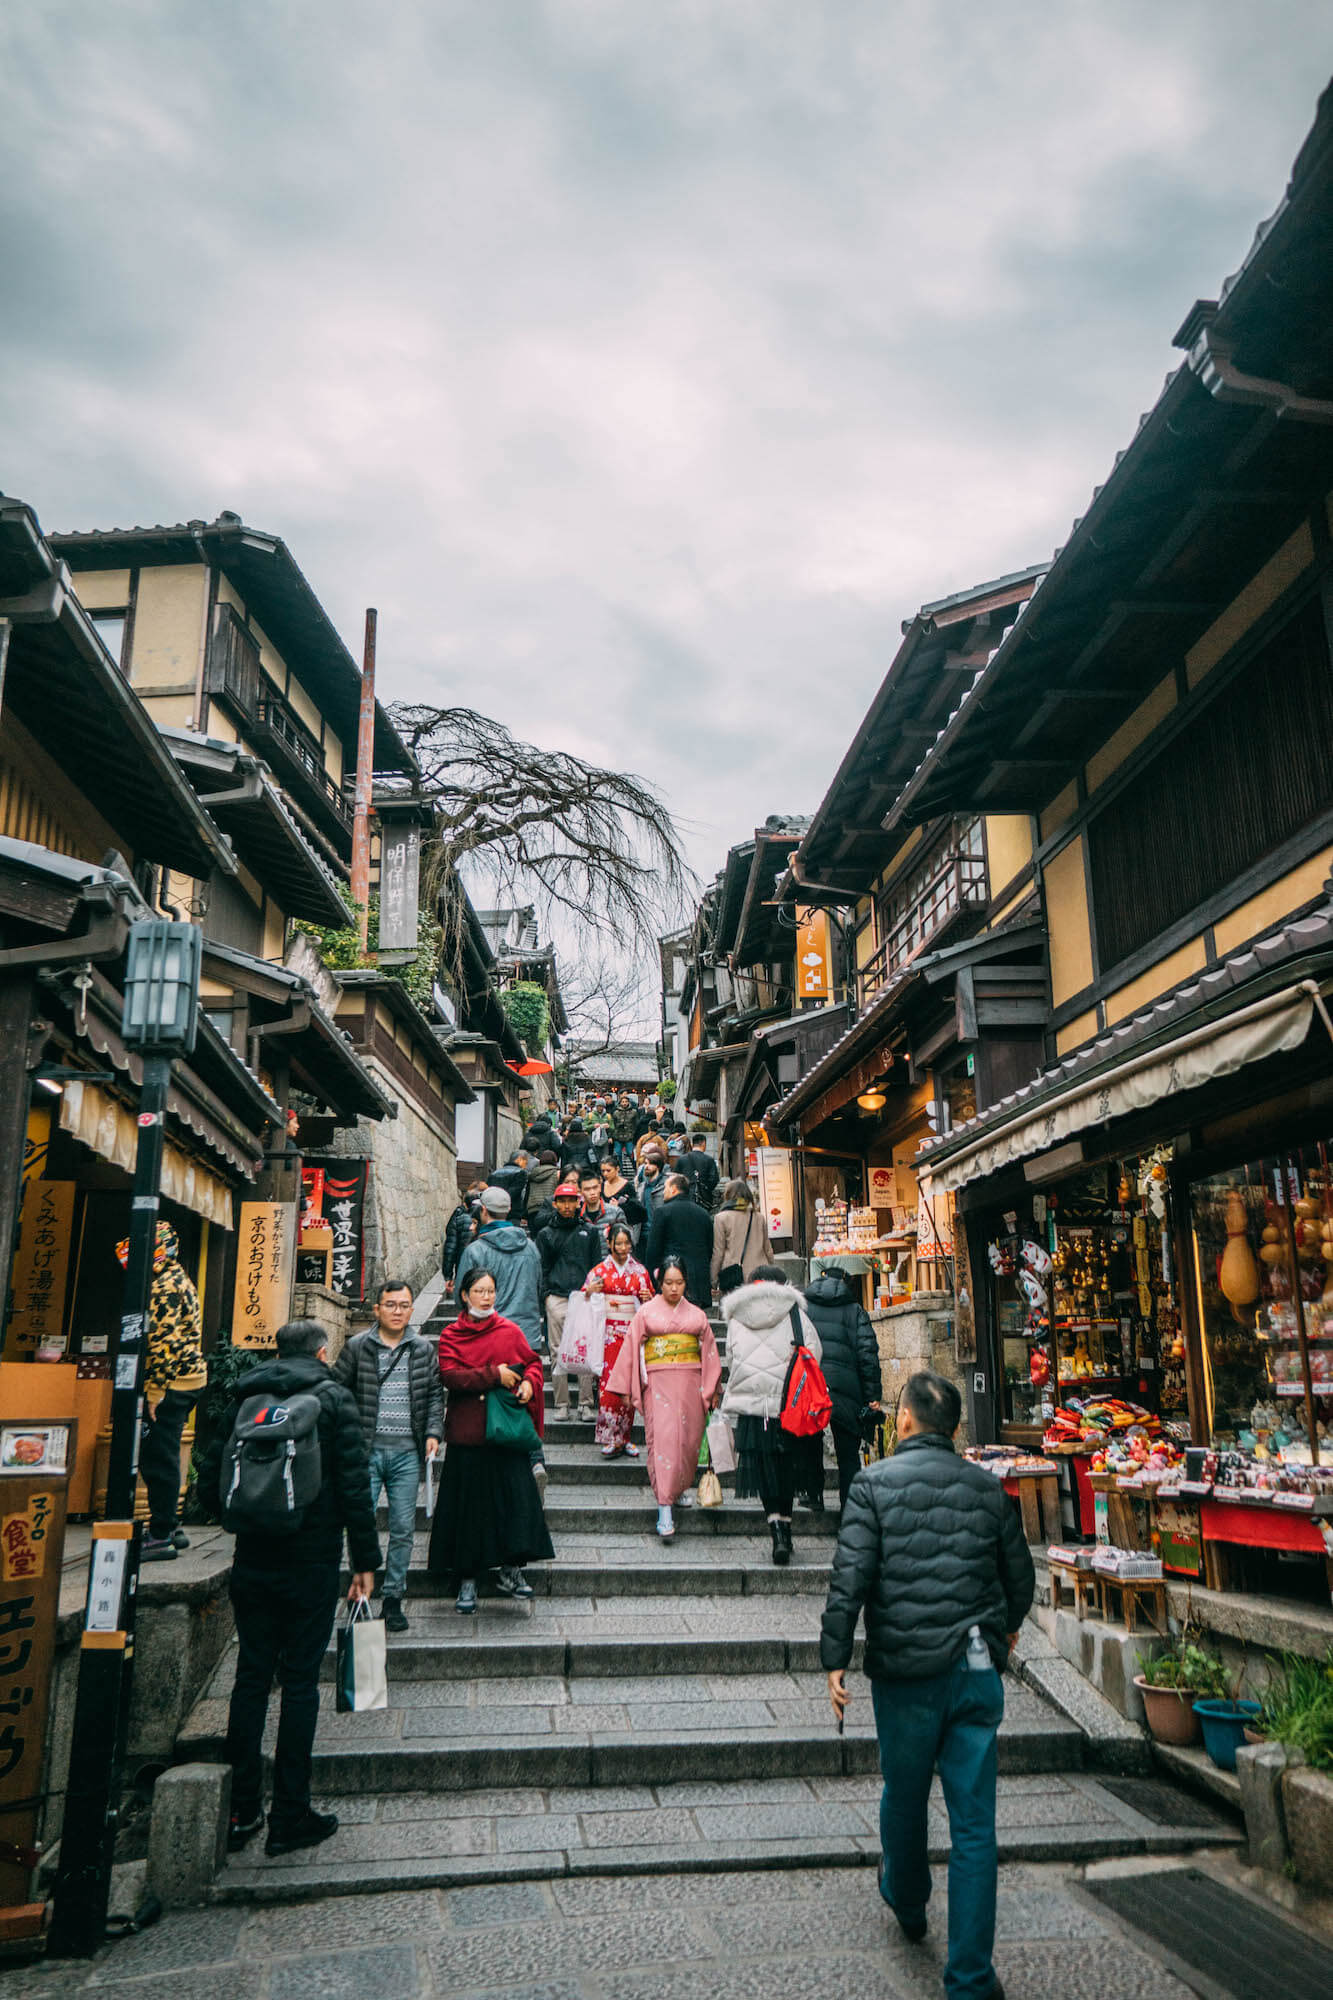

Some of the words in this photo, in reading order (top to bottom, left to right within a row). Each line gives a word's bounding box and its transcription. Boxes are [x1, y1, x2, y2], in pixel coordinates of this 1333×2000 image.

[25, 1189, 59, 1312] くみあげ湯葉
[245, 1216, 267, 1316] 京のおつけもの
[270, 1208, 285, 1283] 野菜から育てた
[331, 1199, 359, 1293] 世界一辛い
[3, 1519, 36, 1577] 食堂
[31, 1496, 51, 1541] マグロ
